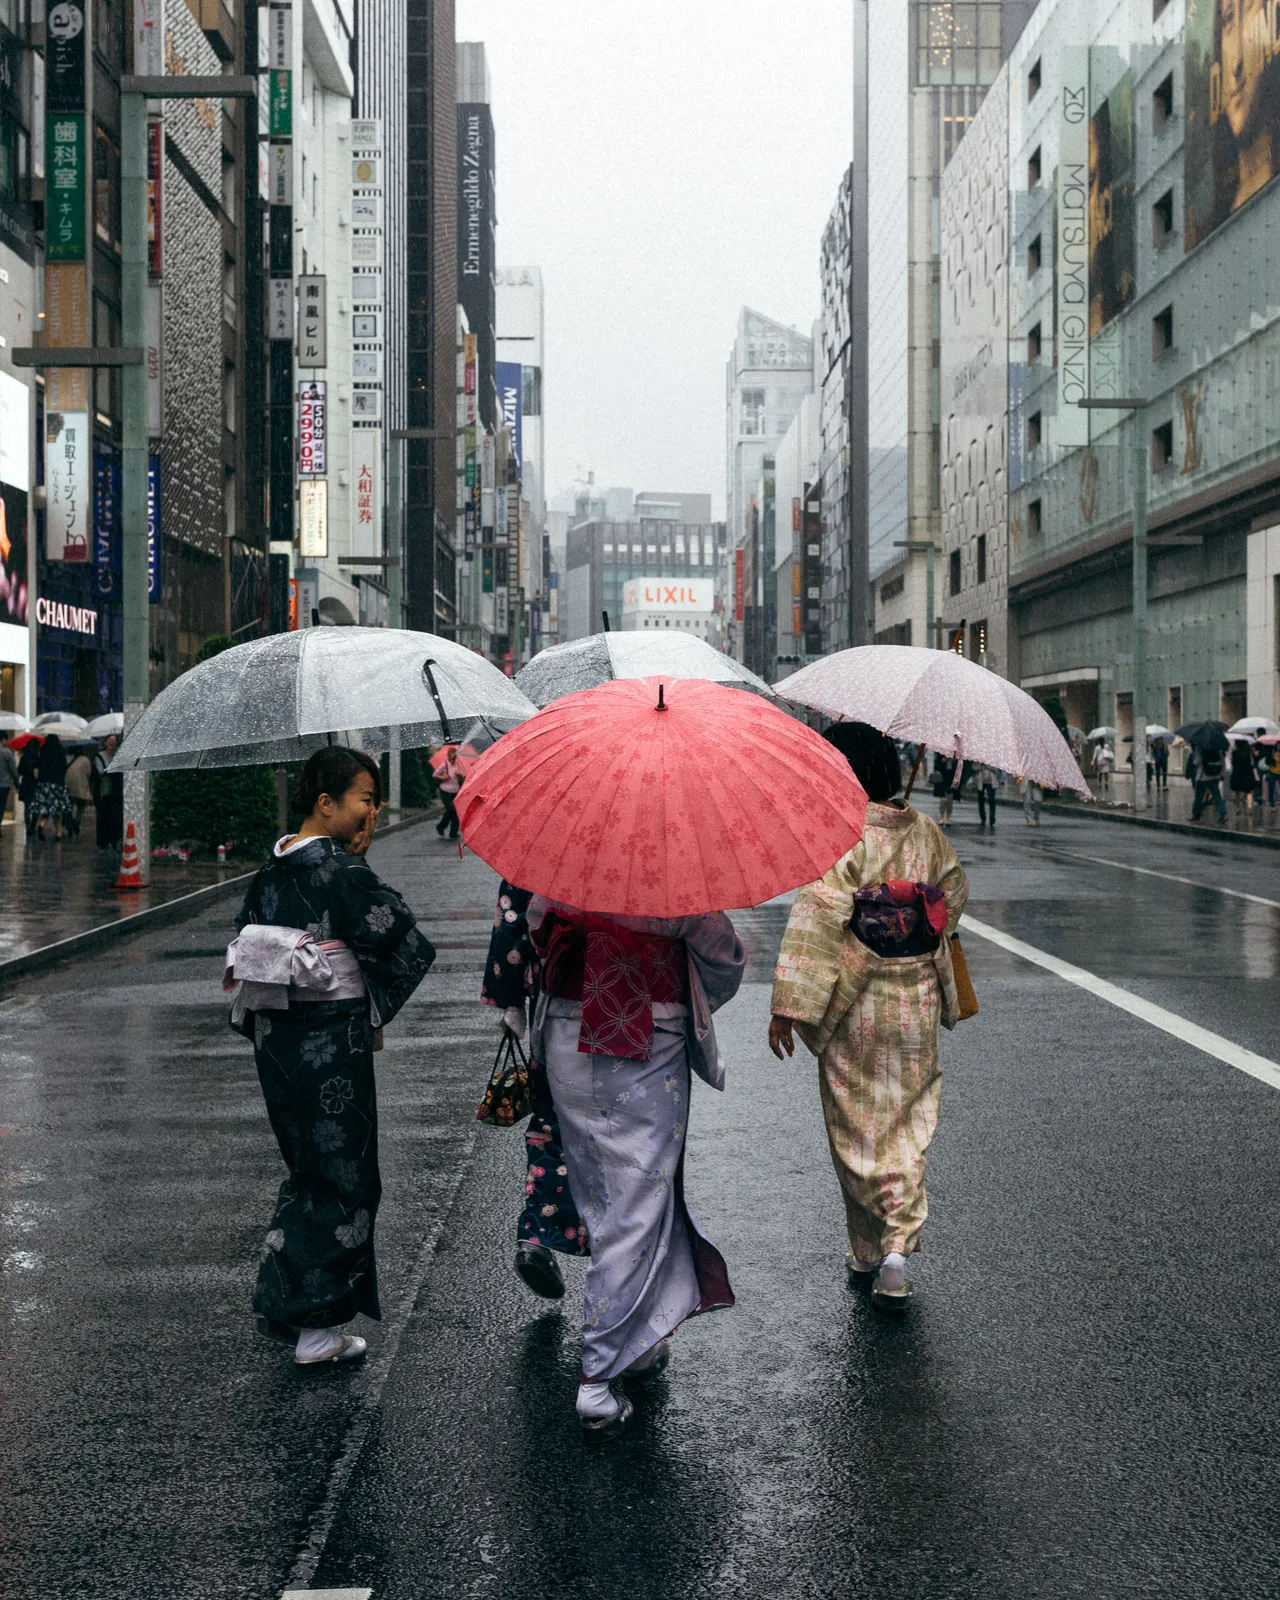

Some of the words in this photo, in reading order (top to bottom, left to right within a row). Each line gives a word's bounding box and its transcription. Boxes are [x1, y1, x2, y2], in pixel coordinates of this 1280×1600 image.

[463, 116, 483, 167] Zegna
[54, 121, 78, 242] 歯科室・キムラ
[463, 170, 483, 276] Ermenegildo
[305, 285, 319, 357] 南風ビル
[301, 404, 313, 471] 2990円
[64, 428, 77, 546] 買取エージェント
[358, 464, 373, 524] 大和証券
[36, 597, 97, 635] CHAUMET
[645, 586, 697, 604] LIXIL
